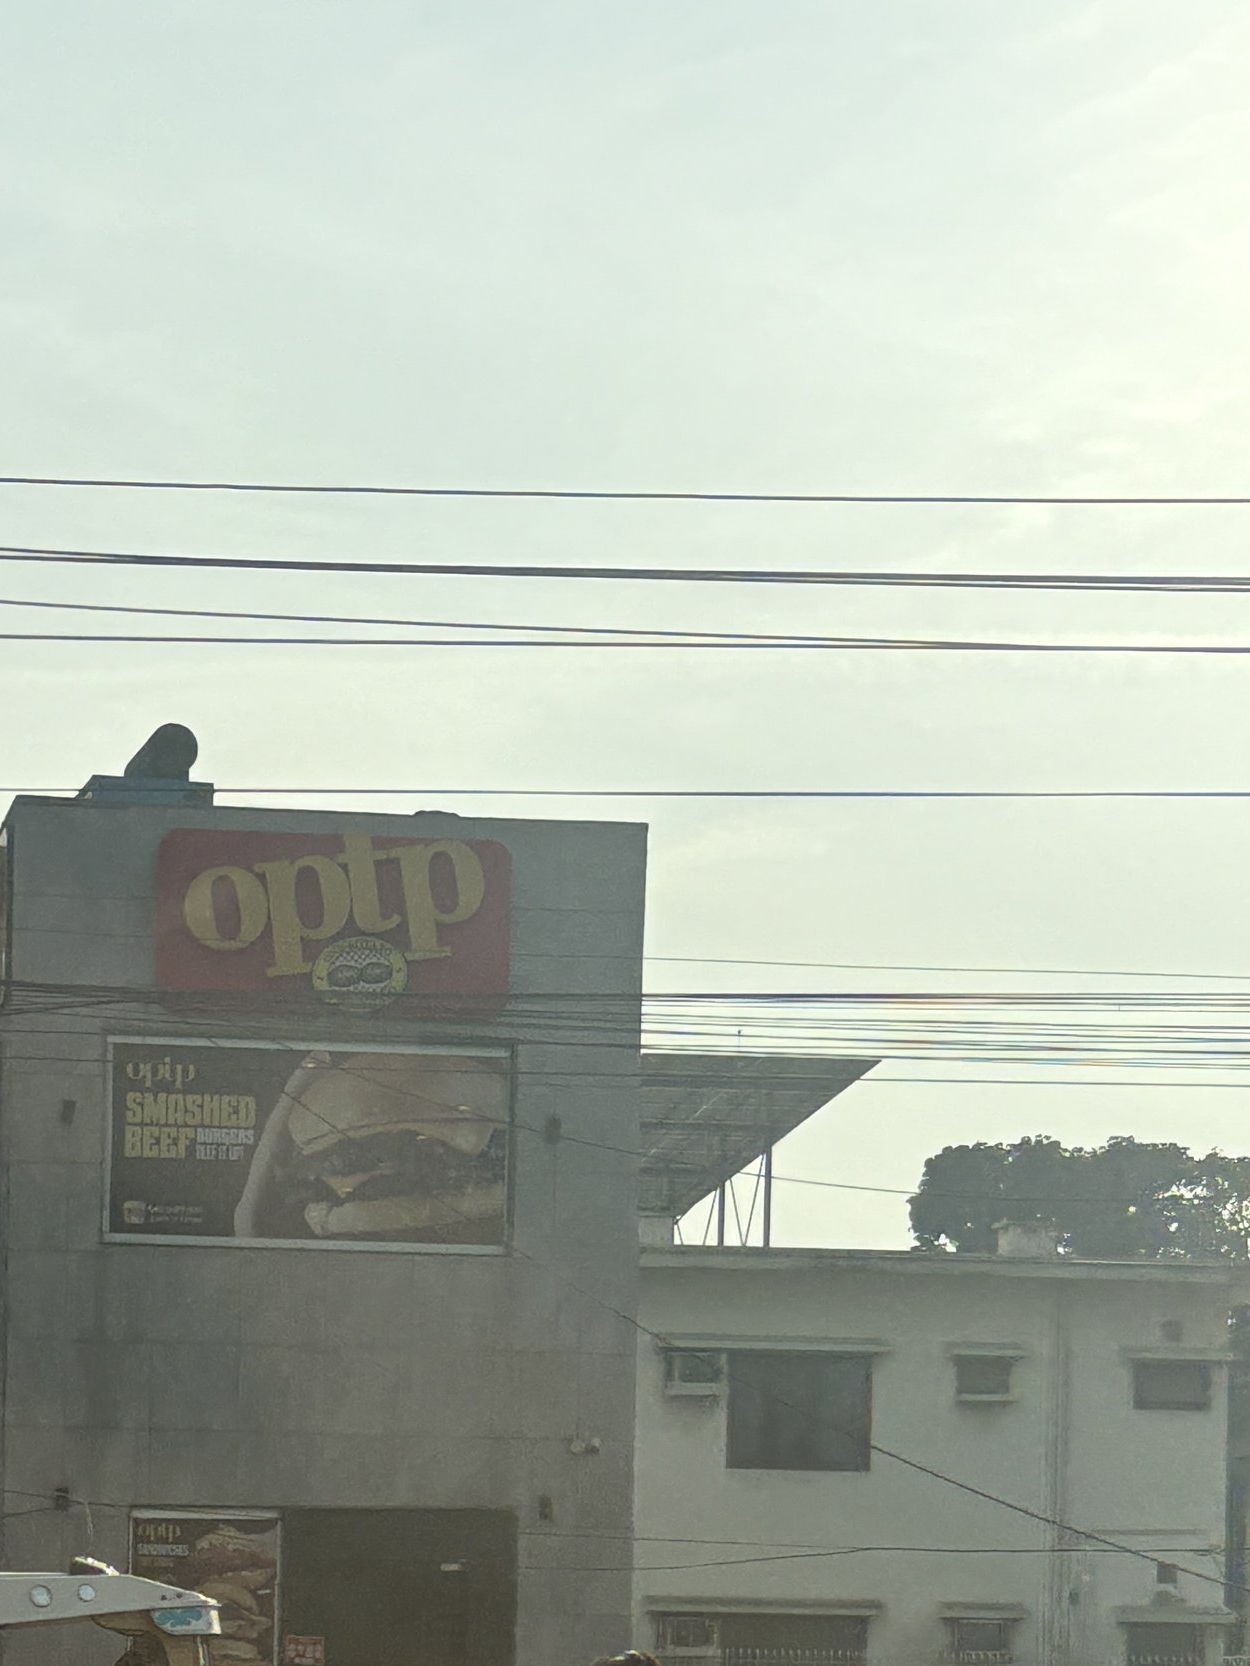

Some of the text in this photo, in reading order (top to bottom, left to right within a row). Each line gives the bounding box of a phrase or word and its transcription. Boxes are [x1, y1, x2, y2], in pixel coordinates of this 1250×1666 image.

[183, 832, 485, 977] optp
[125, 1091, 256, 1128] SMASHED
[124, 1125, 254, 1158] BEEF BURGERS
